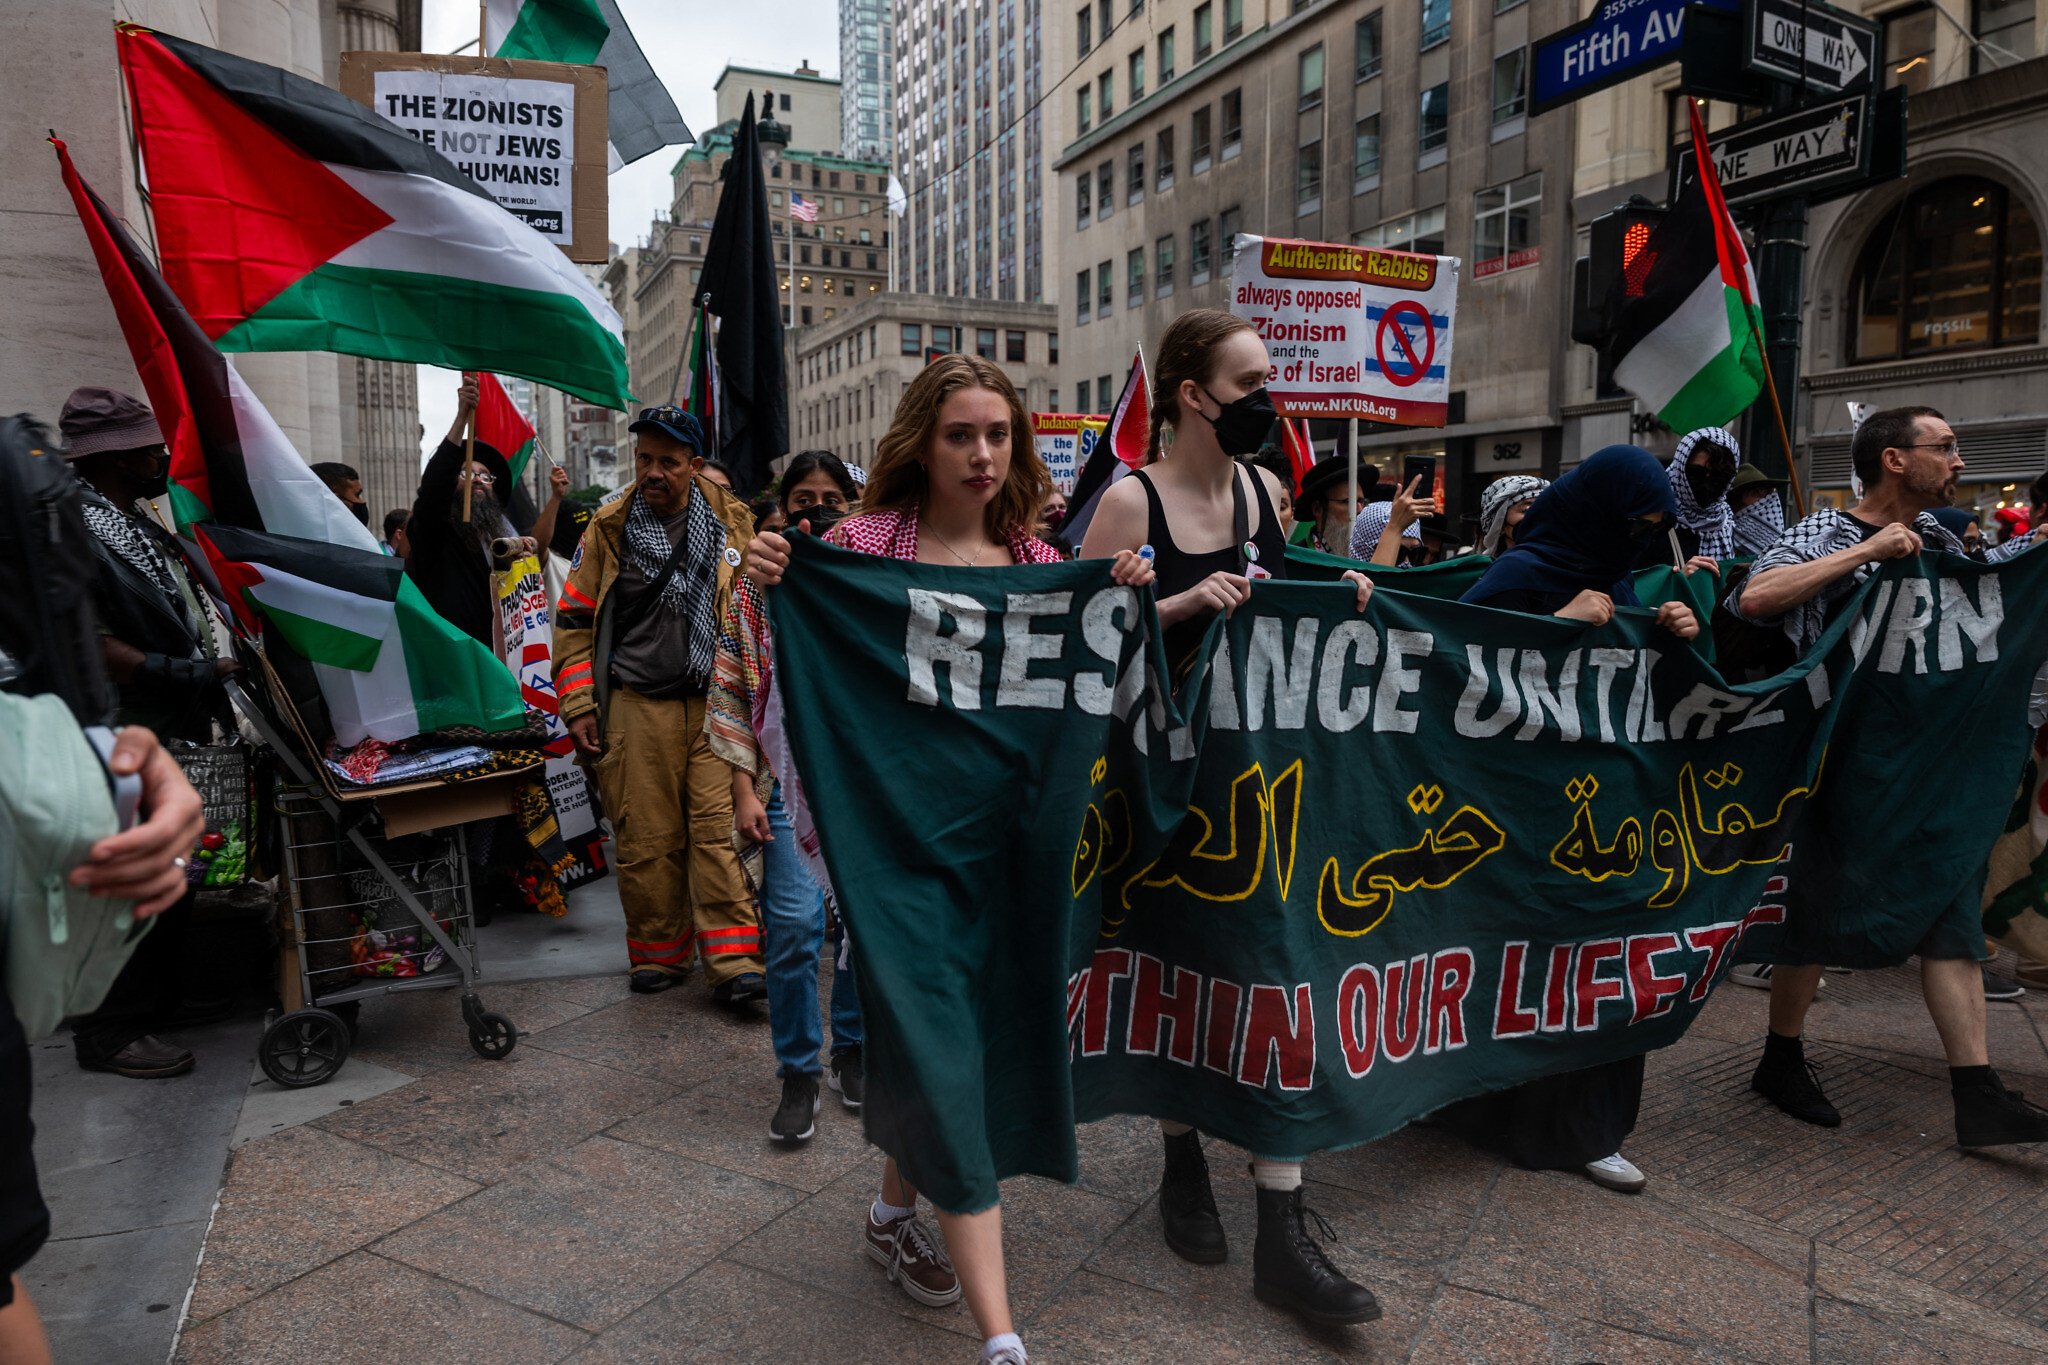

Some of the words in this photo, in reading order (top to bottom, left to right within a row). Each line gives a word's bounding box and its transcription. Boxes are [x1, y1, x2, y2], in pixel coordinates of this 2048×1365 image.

[1604, 0, 1626, 20] 355
[1563, 24, 1630, 82] Fifth
[1640, 1, 1704, 50] Av
[1823, 37, 1857, 72] WAY
[385, 94, 437, 119] THE
[442, 97, 563, 128] ZIONISTS
[441, 130, 491, 155] NOT
[495, 134, 561, 160] JEWS
[1773, 127, 1830, 167] WAY
[458, 161, 560, 187] HUMANS!
[510, 197, 537, 205] WORLD!
[1268, 243, 1363, 272] Authentic
[1366, 252, 1429, 282] Rabbis
[1236, 282, 1292, 311] always
[1296, 288, 1361, 313] opposed
[1251, 316, 1346, 342] Zionism
[1924, 318, 1973, 336] FOSSIL
[1272, 345, 1296, 358] and
[1300, 346, 1319, 358] the
[1284, 361, 1302, 382] of
[1308, 361, 1361, 383] Israel
[1284, 399, 1397, 419] www.NKUSA.org
[1054, 437, 1073, 449] the
[1493, 442, 1522, 461] 362
[1041, 452, 1072, 463] State
[1454, 643, 1665, 743] UNTIL
[551, 776, 584, 794] INTERVE
[560, 805, 571, 815] AS
[1337, 946, 1475, 1080] OUR
